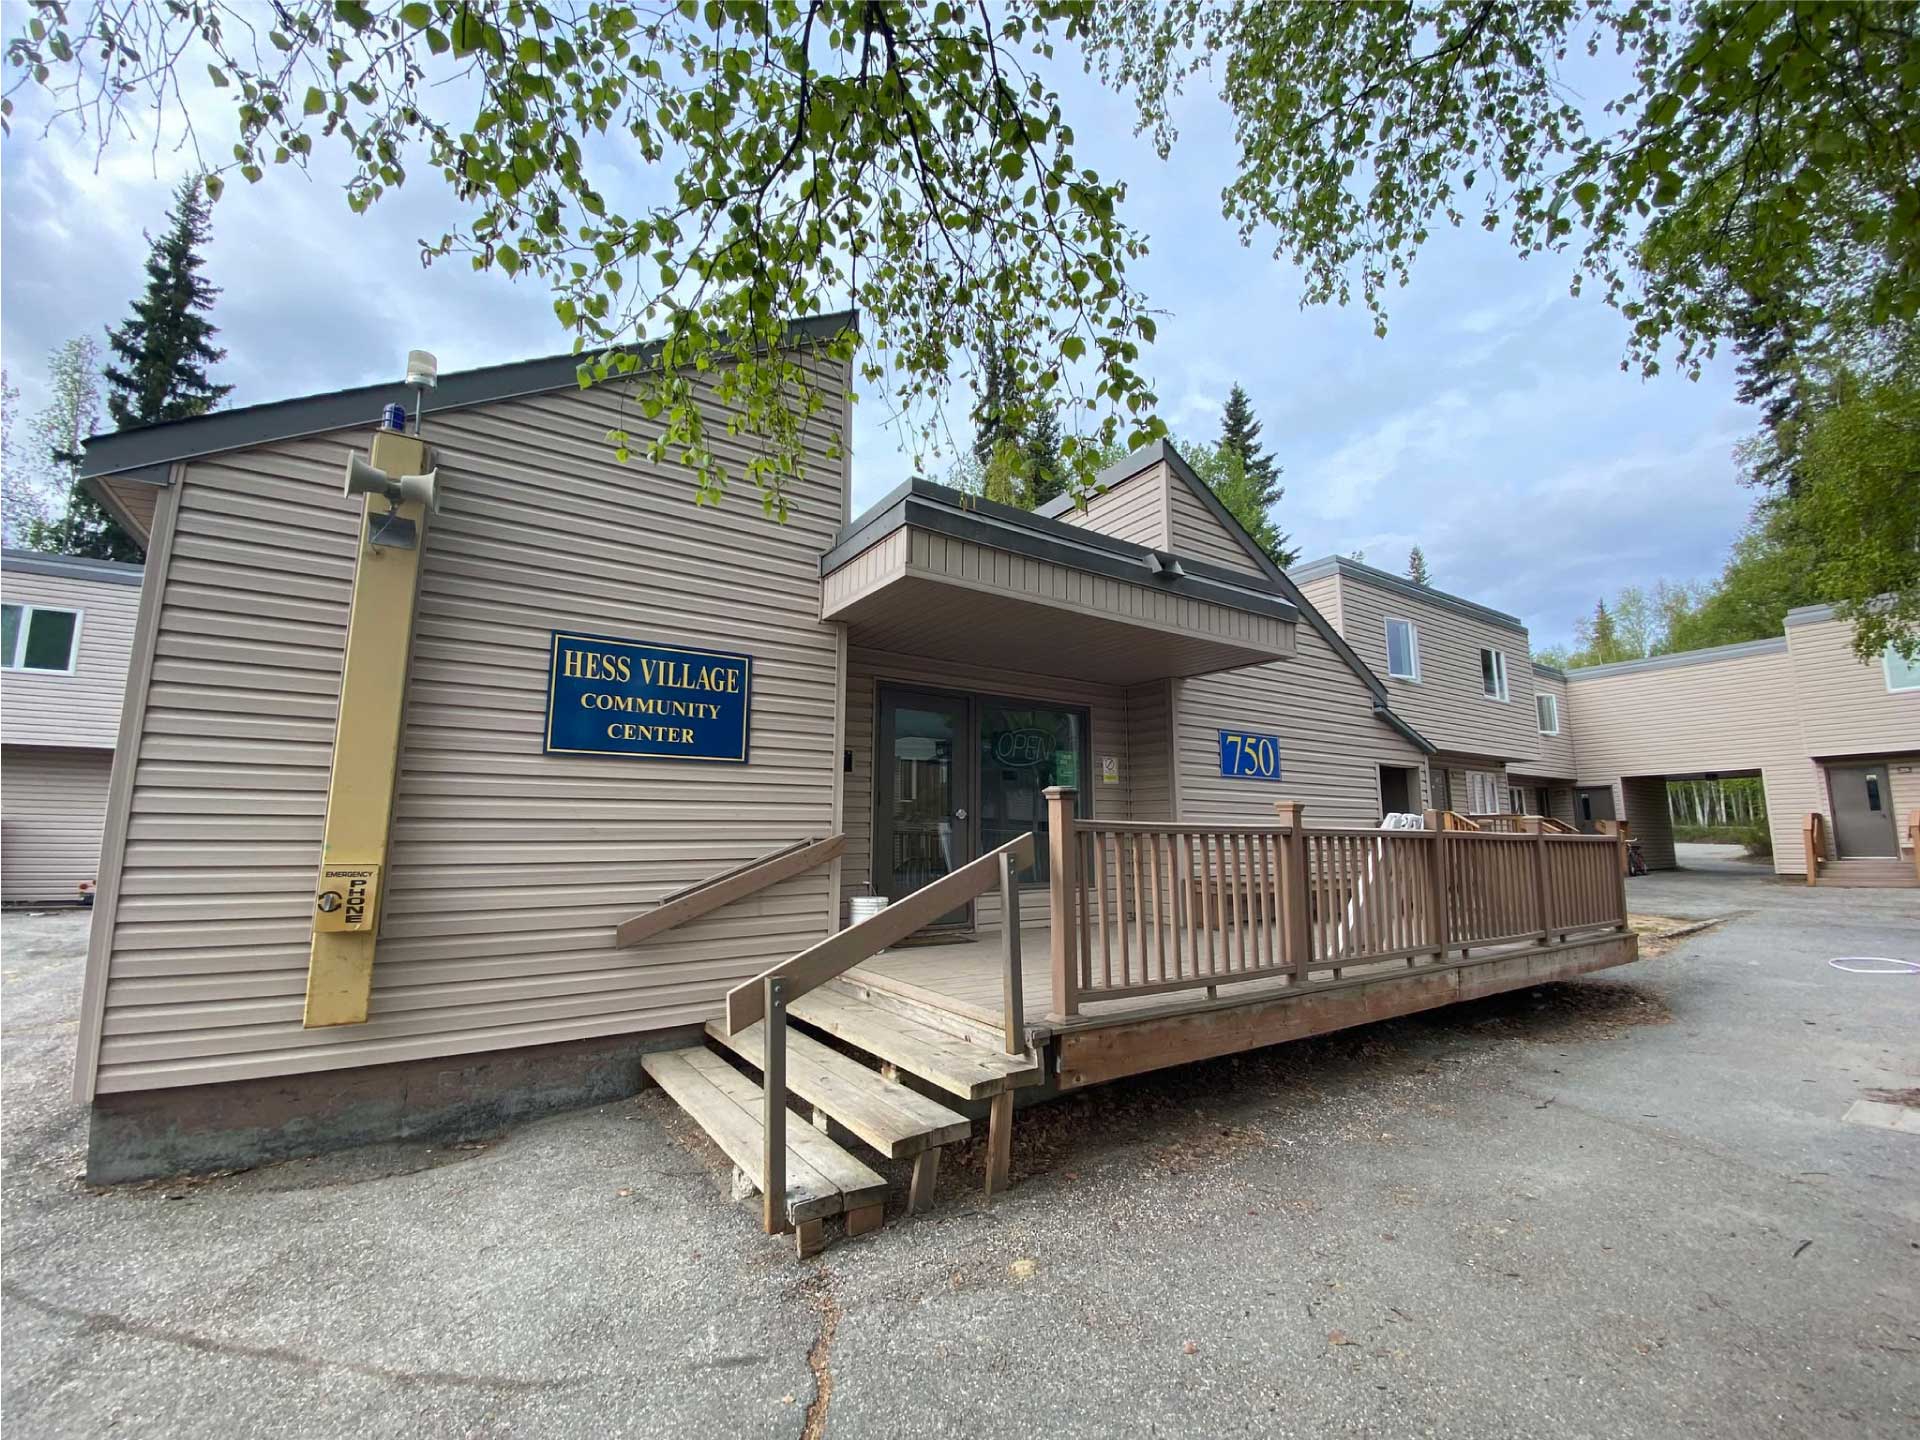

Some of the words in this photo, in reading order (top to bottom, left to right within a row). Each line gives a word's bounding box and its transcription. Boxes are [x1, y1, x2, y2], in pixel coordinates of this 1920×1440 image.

[562, 649, 631, 683] HESS
[640, 658, 739, 694] VILLAGE
[580, 692, 721, 720] COMMUNITY
[607, 723, 695, 744] CENTER
[998, 732, 1051, 760] OPEN
[1226, 735, 1275, 776] 750
[345, 879, 367, 924] PHONE
